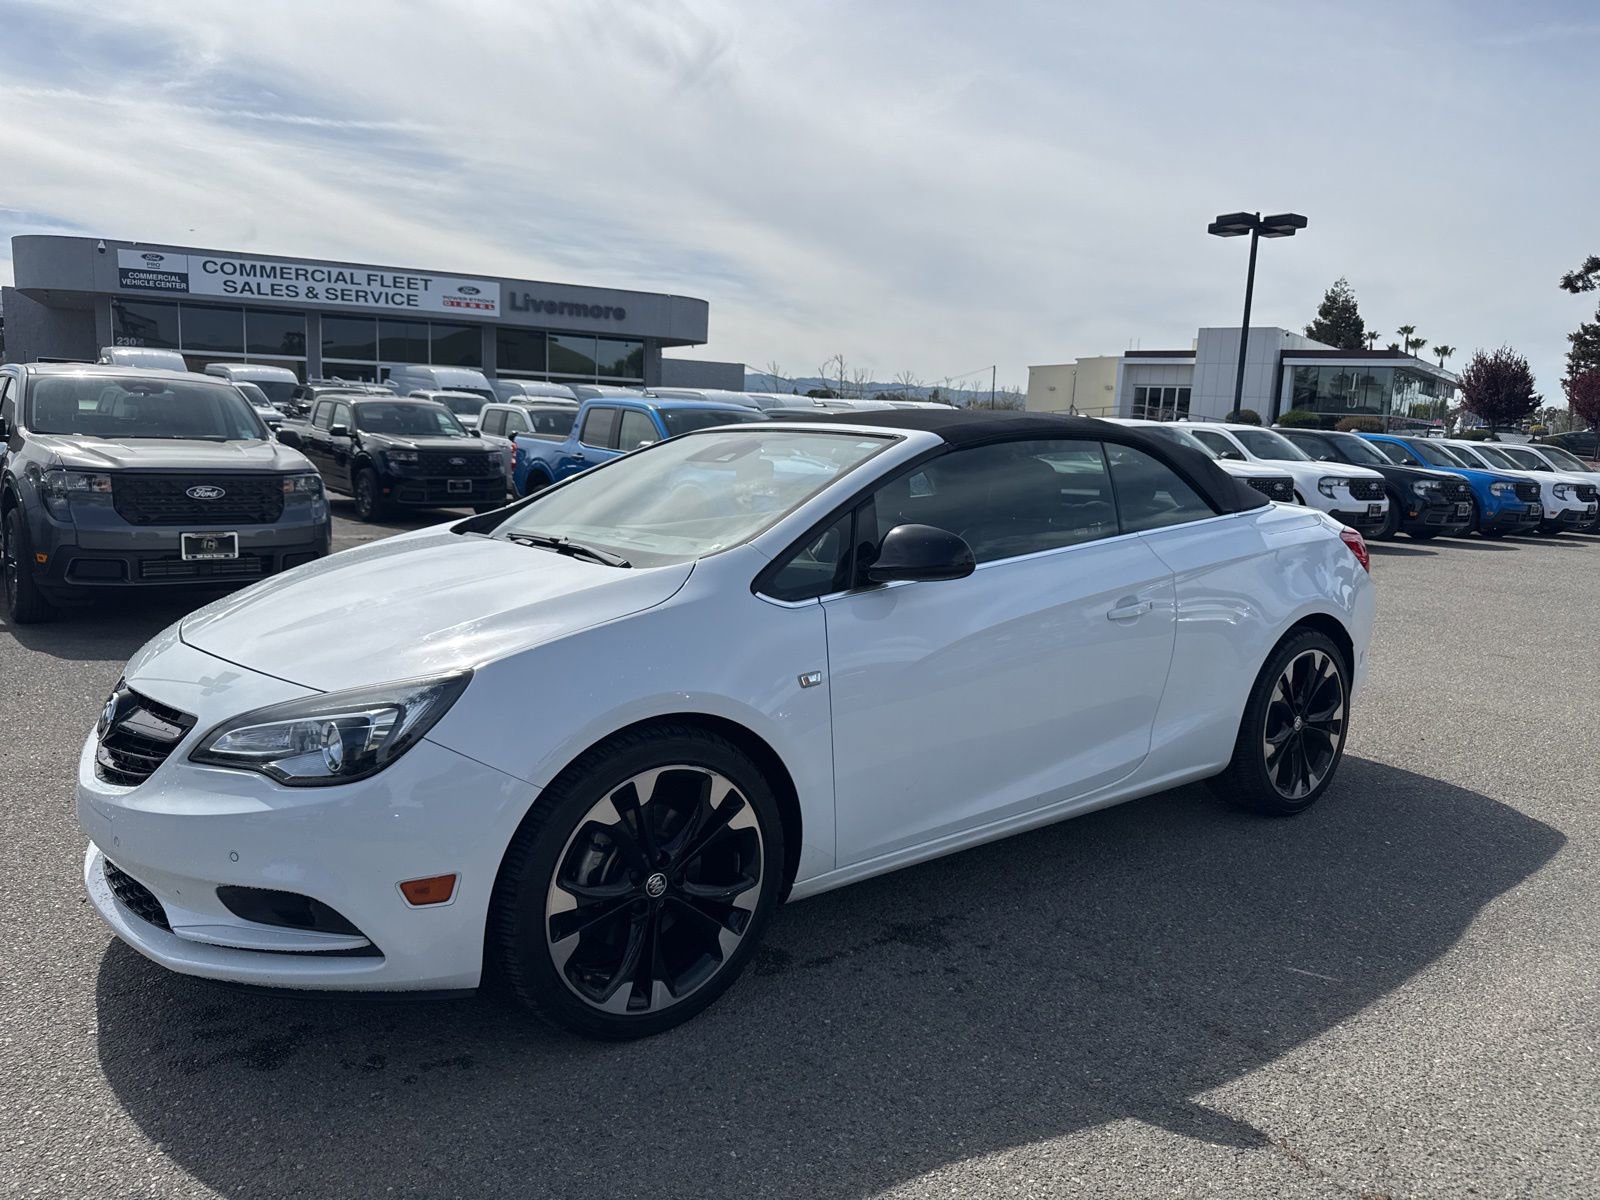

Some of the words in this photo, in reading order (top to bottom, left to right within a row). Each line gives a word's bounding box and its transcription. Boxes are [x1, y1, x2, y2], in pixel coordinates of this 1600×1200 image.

[122, 278, 155, 287] VEHICLE
[156, 282, 187, 290] CENTER
[129, 272, 181, 282] COMMERCIAL
[202, 260, 361, 285] COMMERCIAL
[367, 274, 432, 291] FLEET
[223, 280, 300, 298] SALES
[304, 286, 320, 299] &
[325, 288, 419, 307] SERVICE
[510, 292, 626, 321] Livermore
[192, 487, 219, 498] Ford
